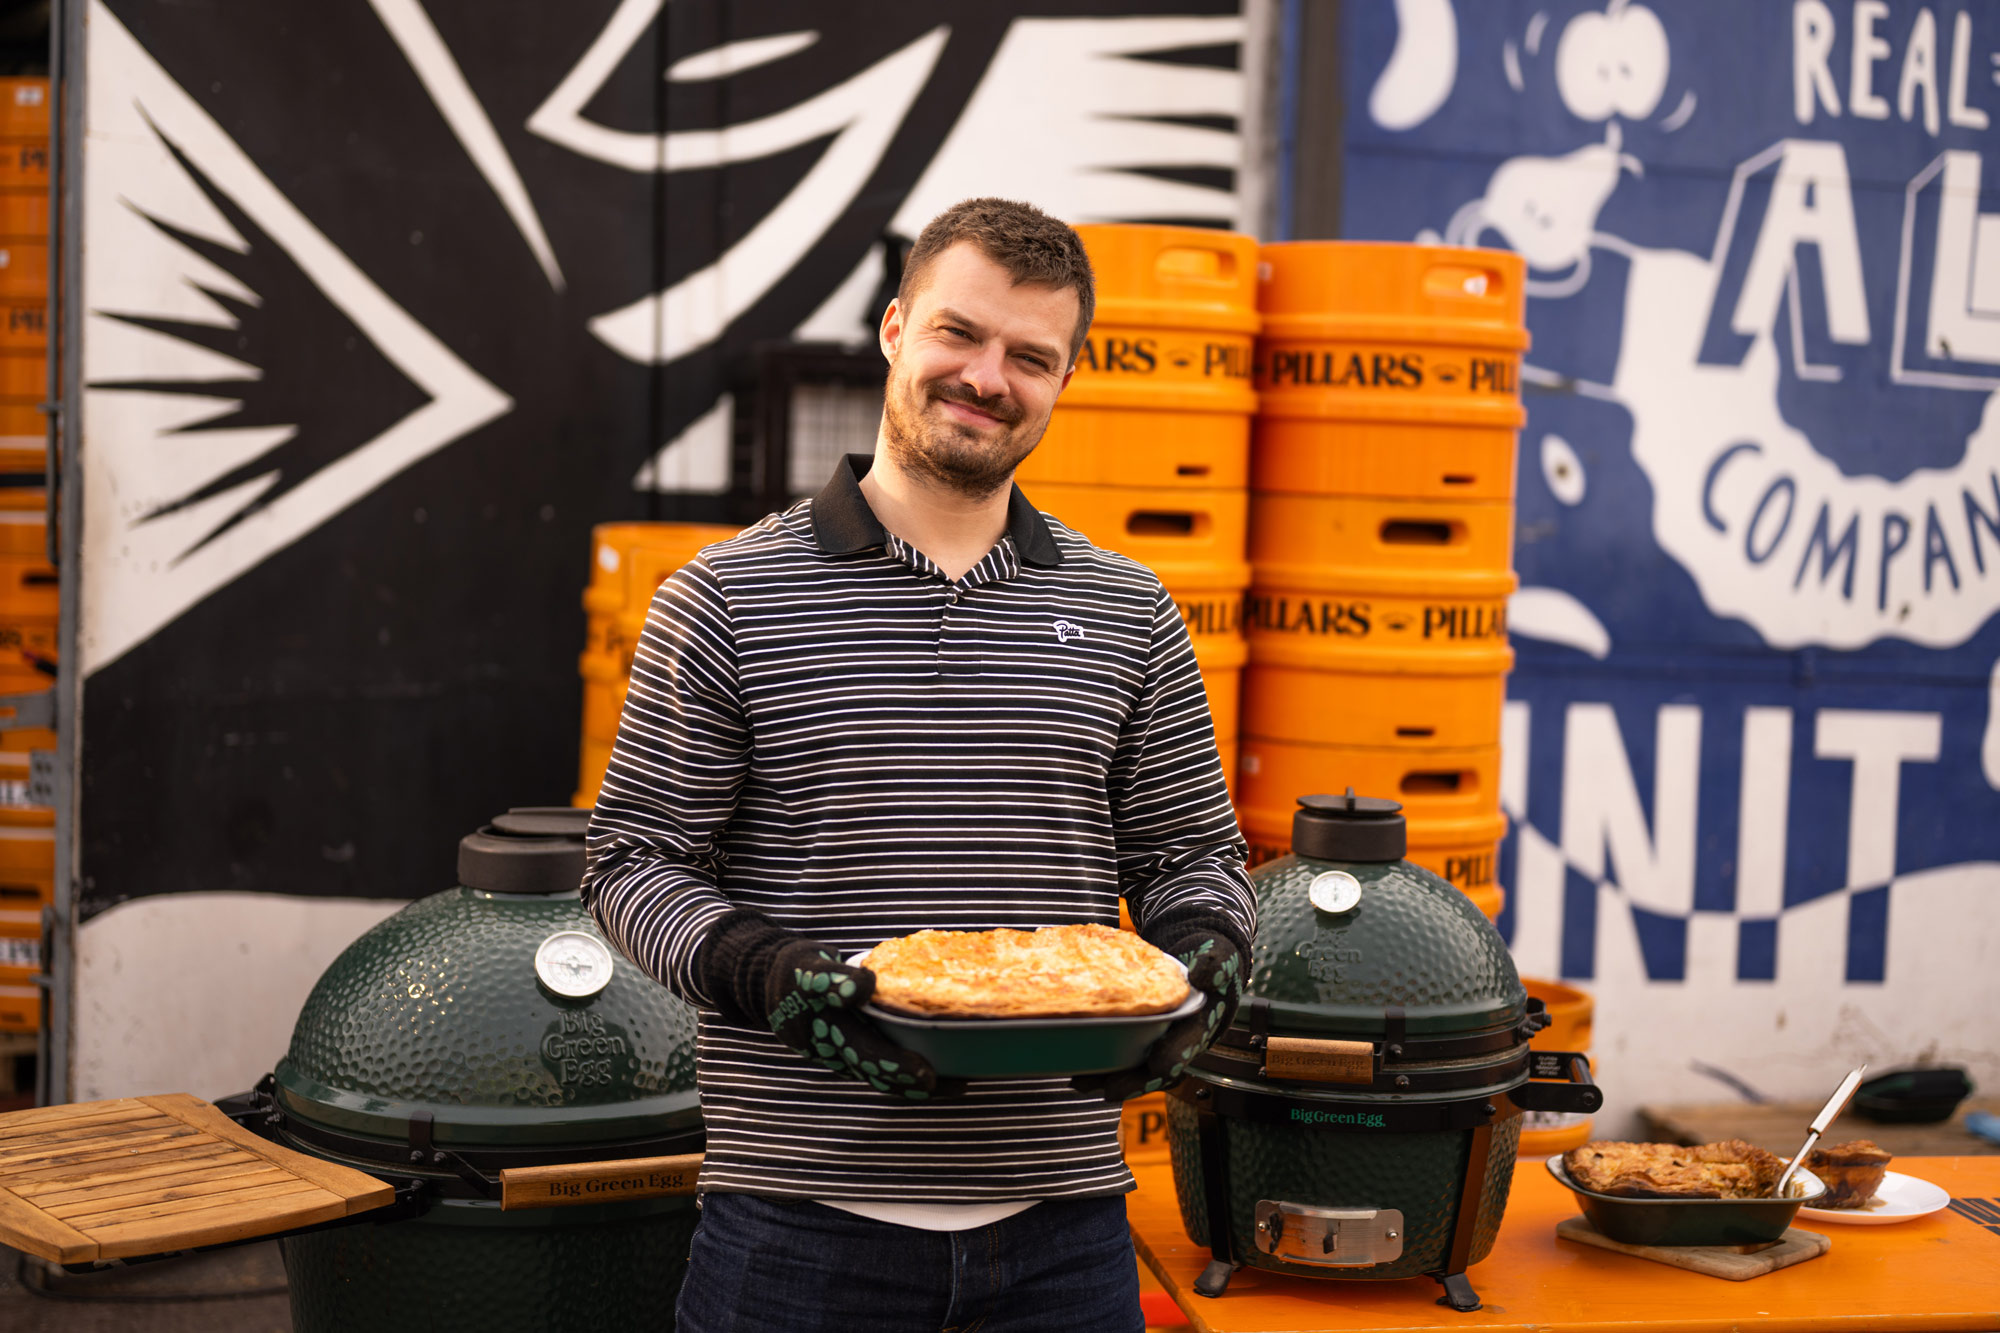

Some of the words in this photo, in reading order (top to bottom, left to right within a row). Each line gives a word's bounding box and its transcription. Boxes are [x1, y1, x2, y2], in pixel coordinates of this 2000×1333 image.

[1793, 0, 1990, 138] REAL
[1271, 350, 1424, 390] PILLARS
[1055, 621, 1082, 640] Patta
[558, 1009, 607, 1037] Big
[543, 1033, 627, 1060] Green
[561, 1058, 612, 1087] Egg
[550, 1182, 581, 1197] Big
[585, 1177, 644, 1193] Green
